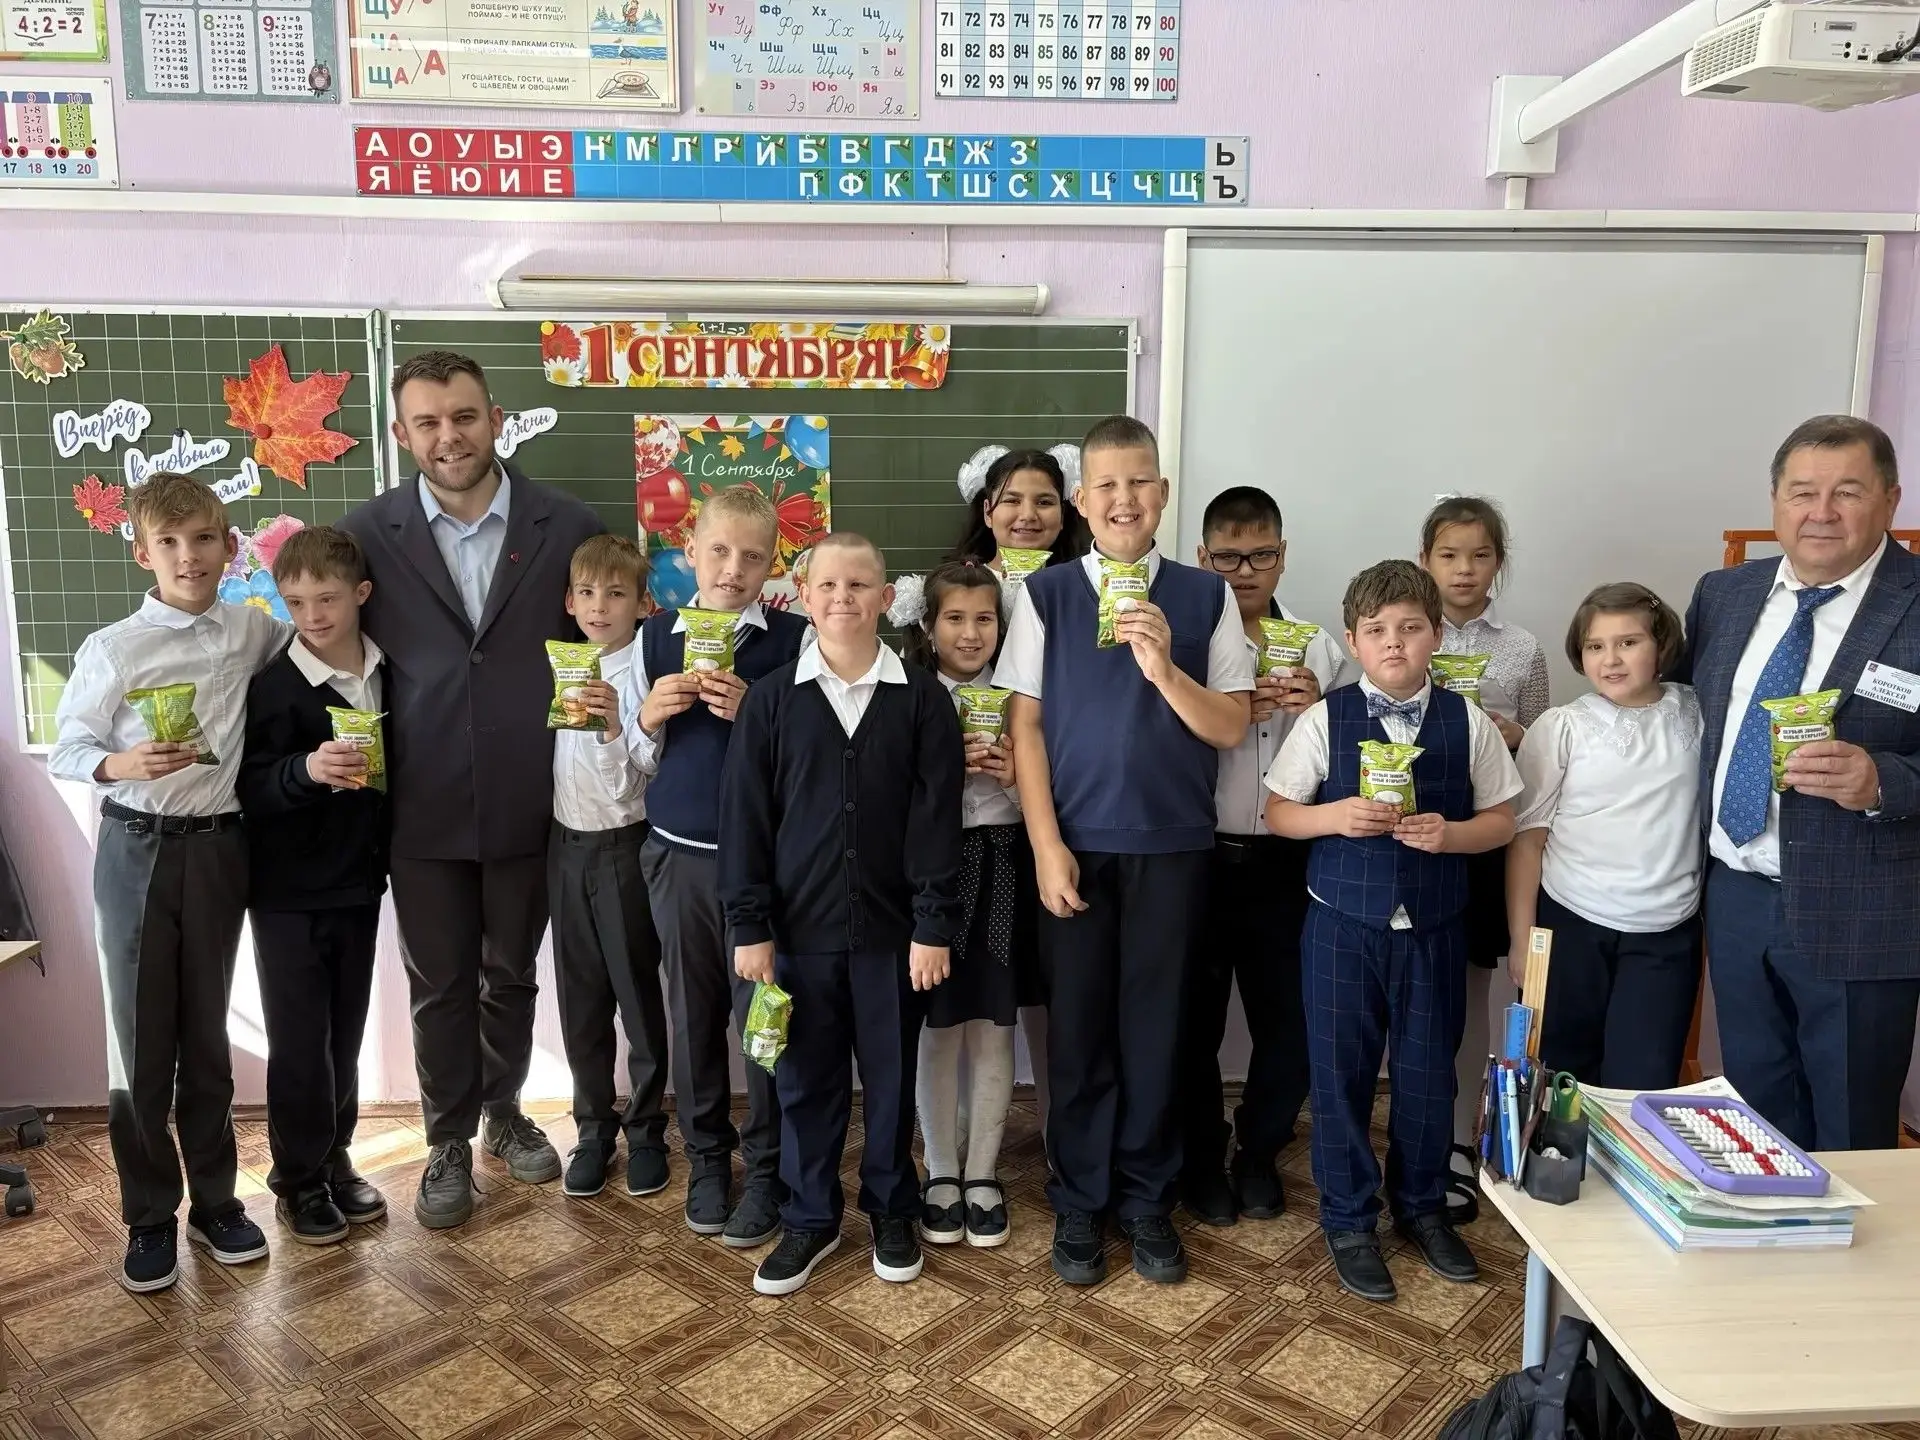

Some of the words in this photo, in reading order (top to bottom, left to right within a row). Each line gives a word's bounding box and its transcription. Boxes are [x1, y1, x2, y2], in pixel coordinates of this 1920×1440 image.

[365, 0, 402, 19] ЩУ
[708, 3, 724, 15] Уу
[760, 5, 781, 16] Фф
[812, 6, 827, 16] Хх
[862, 7, 880, 19] Цц
[19, 16, 28, 32] 4
[43, 16, 53, 33] 2
[72, 17, 82, 33] 2
[145, 13, 156, 29] 7
[204, 14, 214, 30] 8
[263, 15, 274, 32] 9
[735, 16, 753, 43] Уу
[777, 16, 804, 44] Фф
[825, 18, 854, 37] Хх
[878, 20, 904, 43] Цц
[941, 12, 953, 27] 71
[964, 13, 981, 28] 72
[989, 13, 1005, 28] 73
[1013, 13, 1030, 28] 74
[1038, 14, 1054, 29] 75
[1062, 14, 1078, 29] 76
[1086, 15, 1103, 30] 77
[1111, 15, 1127, 30] 78
[1135, 16, 1151, 30] 79
[1159, 16, 1176, 31] 80
[710, 40, 725, 50] Чч
[760, 42, 783, 52] Шш
[813, 43, 837, 55] Щщ
[940, 43, 953, 58] 81
[964, 44, 981, 59] 82
[988, 44, 1005, 59] 83
[1013, 44, 1029, 59] 84
[1037, 45, 1054, 60] 85
[1061, 45, 1078, 60] 86
[1086, 46, 1102, 60] 87
[1110, 46, 1126, 61] 88
[1134, 46, 1150, 61] 89
[1159, 47, 1175, 62] 90
[424, 50, 446, 75] А
[731, 54, 753, 73] Чч
[768, 55, 804, 73] Шш
[817, 56, 854, 79] Щщ
[368, 66, 409, 89] ЩА
[462, 74, 515, 82] УГОЩАЙТЕСЬ,
[760, 80, 775, 90] Ээ
[812, 82, 838, 91] Юю
[863, 83, 878, 93] Яя
[940, 74, 953, 89] 91
[964, 74, 981, 89] 92
[988, 75, 1005, 90] 93
[1012, 75, 1029, 90] 94
[1037, 76, 1053, 90] 95
[1061, 76, 1078, 91] 96
[1085, 76, 1102, 91] 97
[1109, 76, 1125, 92] 98
[1133, 77, 1150, 92] 99
[1155, 77, 1176, 92] 100
[27, 92, 36, 103] 9
[67, 94, 83, 104] 10
[786, 93, 804, 112] Ээ
[826, 95, 854, 113] Юю
[879, 97, 904, 114] Яя
[24, 116, 41, 124] 2+7
[66, 113, 83, 121] 2+8
[67, 122, 83, 130] 3+7
[366, 132, 389, 156] А
[409, 132, 432, 157] О
[454, 133, 474, 158] У
[494, 134, 522, 159] Ы
[540, 135, 562, 160] Э
[585, 136, 605, 160] Н
[627, 137, 649, 160] М
[671, 138, 691, 162] Л
[714, 138, 732, 162] Р
[756, 136, 775, 166] Й
[798, 139, 818, 163] Б
[840, 140, 861, 164] В
[885, 140, 900, 164] Г
[924, 138, 946, 166] Д
[963, 140, 990, 165] Ж
[1010, 140, 1028, 165] З
[1216, 143, 1235, 166] Ь
[3, 163, 17, 173] 17
[28, 163, 42, 173] 18
[52, 163, 67, 174] 19
[77, 164, 91, 174] 20
[369, 166, 390, 190] Я
[413, 164, 432, 194] Ё
[451, 167, 481, 192] Ю
[500, 169, 519, 192] И
[544, 169, 561, 193] Е
[800, 173, 818, 197] П
[839, 172, 864, 197] Ф
[884, 173, 901, 197] К
[926, 173, 944, 197] Т
[964, 173, 991, 197] Ш
[1009, 174, 1029, 198] С
[1050, 174, 1070, 198] Х
[1092, 172, 1111, 200] Ц
[1134, 174, 1151, 198] Ч
[1170, 173, 1199, 201] Щ
[1213, 176, 1237, 199] Ъ
[582, 324, 620, 386] 1
[627, 335, 902, 380] СЕНТЯБРЯ!
[60, 406, 146, 452] Вперёд,
[501, 415, 551, 451] ужны
[131, 455, 147, 482] к
[156, 436, 224, 471] новым
[682, 454, 695, 475] 1
[701, 454, 795, 483] Сентября
[1872, 686, 1906, 700] АЛЕКСЕЙ
[1873, 678, 1912, 694] КОРОТКОВ
